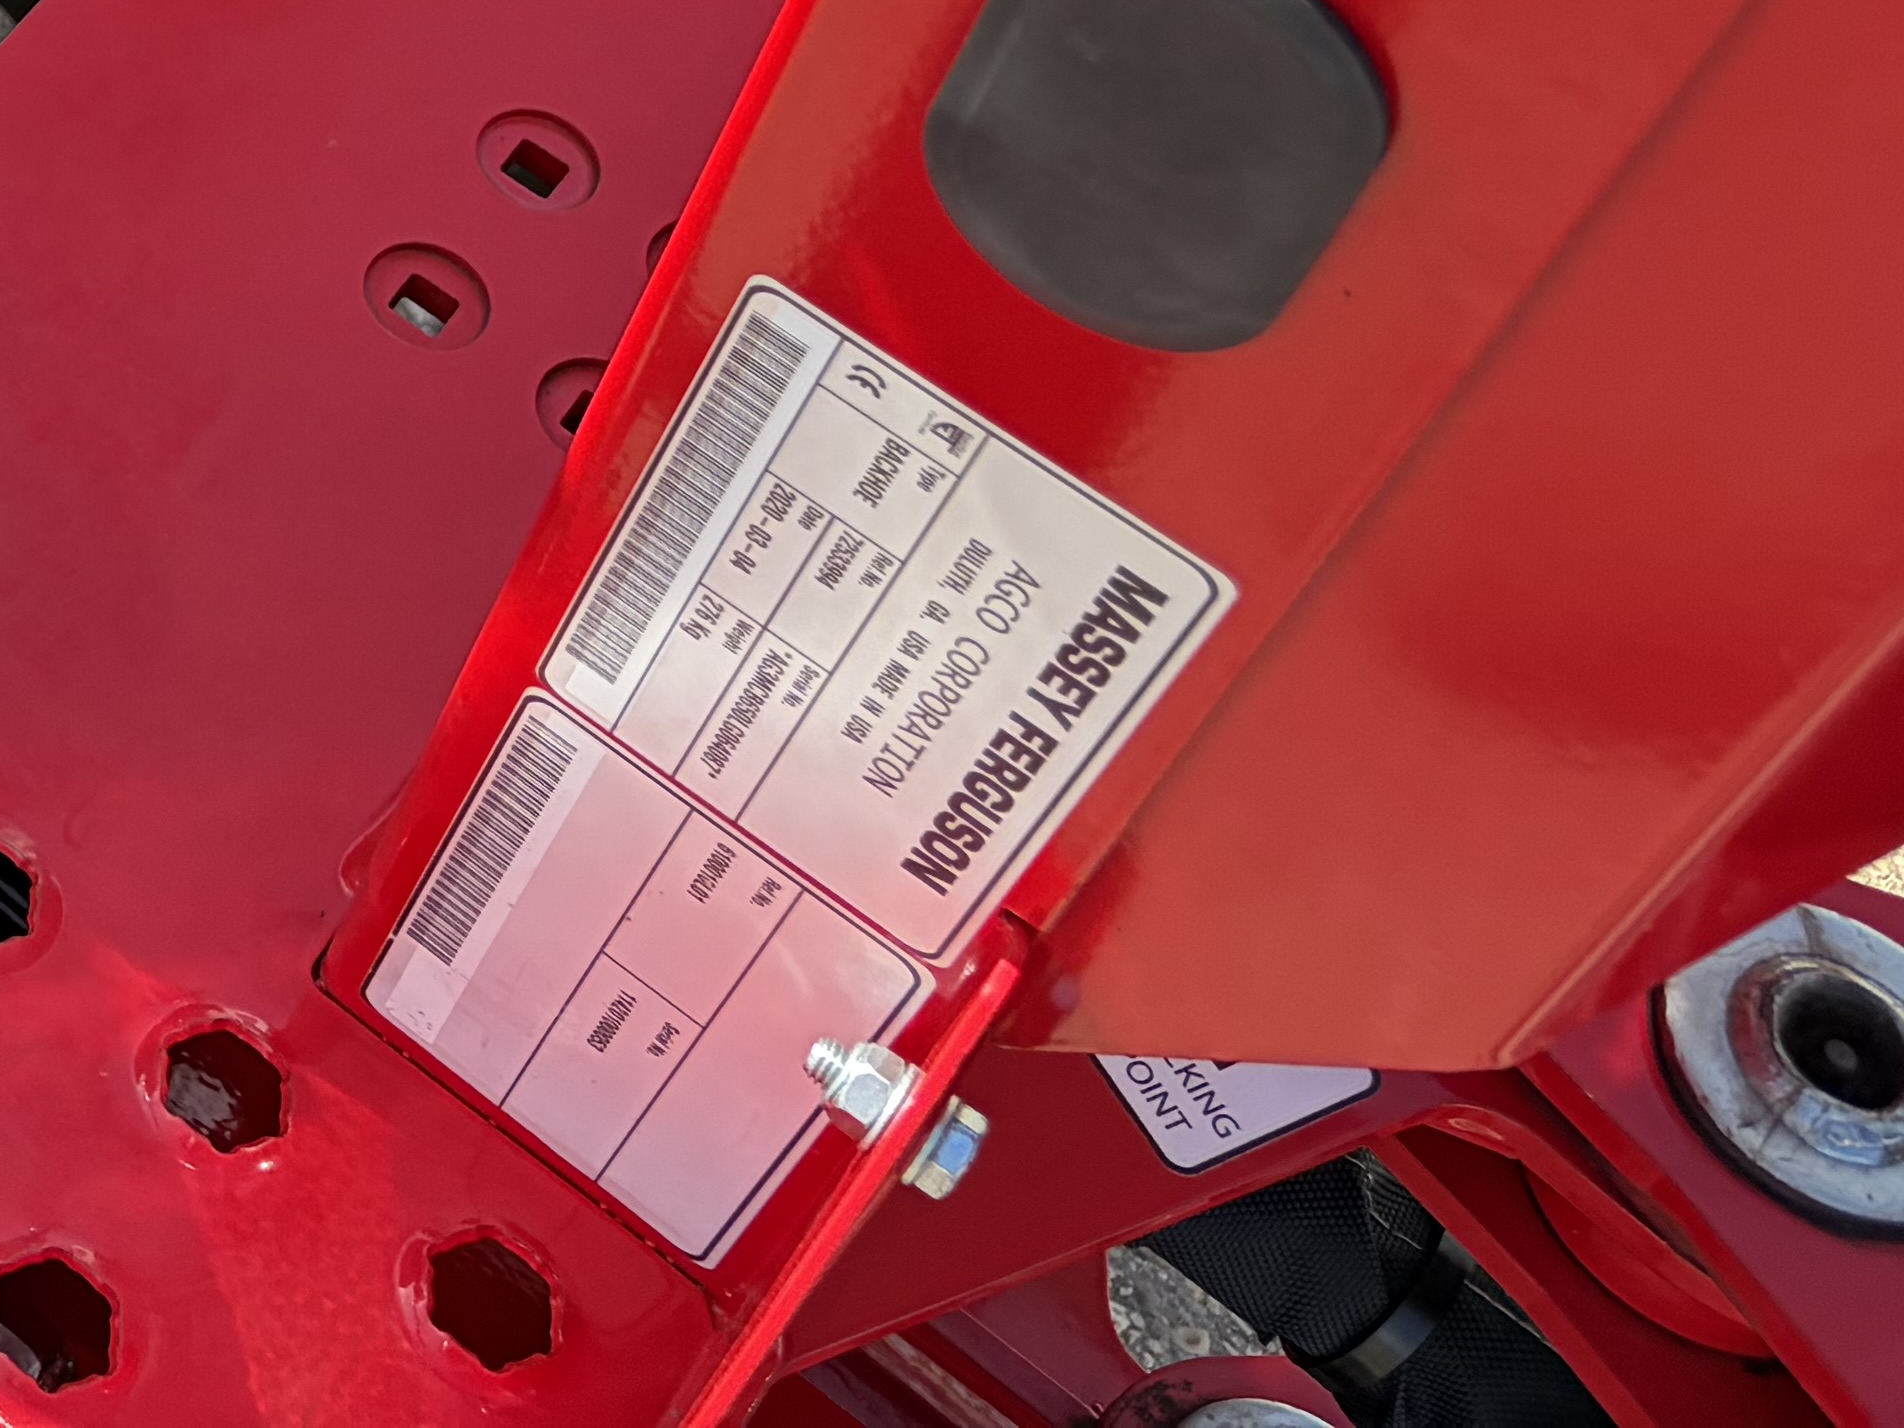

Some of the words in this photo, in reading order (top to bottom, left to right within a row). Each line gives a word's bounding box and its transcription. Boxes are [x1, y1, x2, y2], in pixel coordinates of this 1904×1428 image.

[853, 438, 910, 508] BACKHOE
[917, 466, 946, 492] Type
[798, 505, 824, 530] Date
[815, 531, 864, 590] 72533994
[938, 538, 993, 595] DULUTH,
[695, 594, 724, 625] 276
[976, 560, 1041, 634] AGCO
[680, 618, 711, 640] Kg
[723, 619, 755, 654] Weight
[897, 631, 931, 660] USA
[1027, 566, 1169, 731] MASSEY
[792, 665, 820, 696] Serial
[872, 659, 910, 699] MADE
[781, 690, 804, 707] No.
[860, 696, 885, 717] IN
[841, 715, 872, 744] USA
[862, 637, 990, 798] CORPORATION
[901, 711, 1058, 896] FERGUSON
[1163, 1057, 1241, 1139] KING
